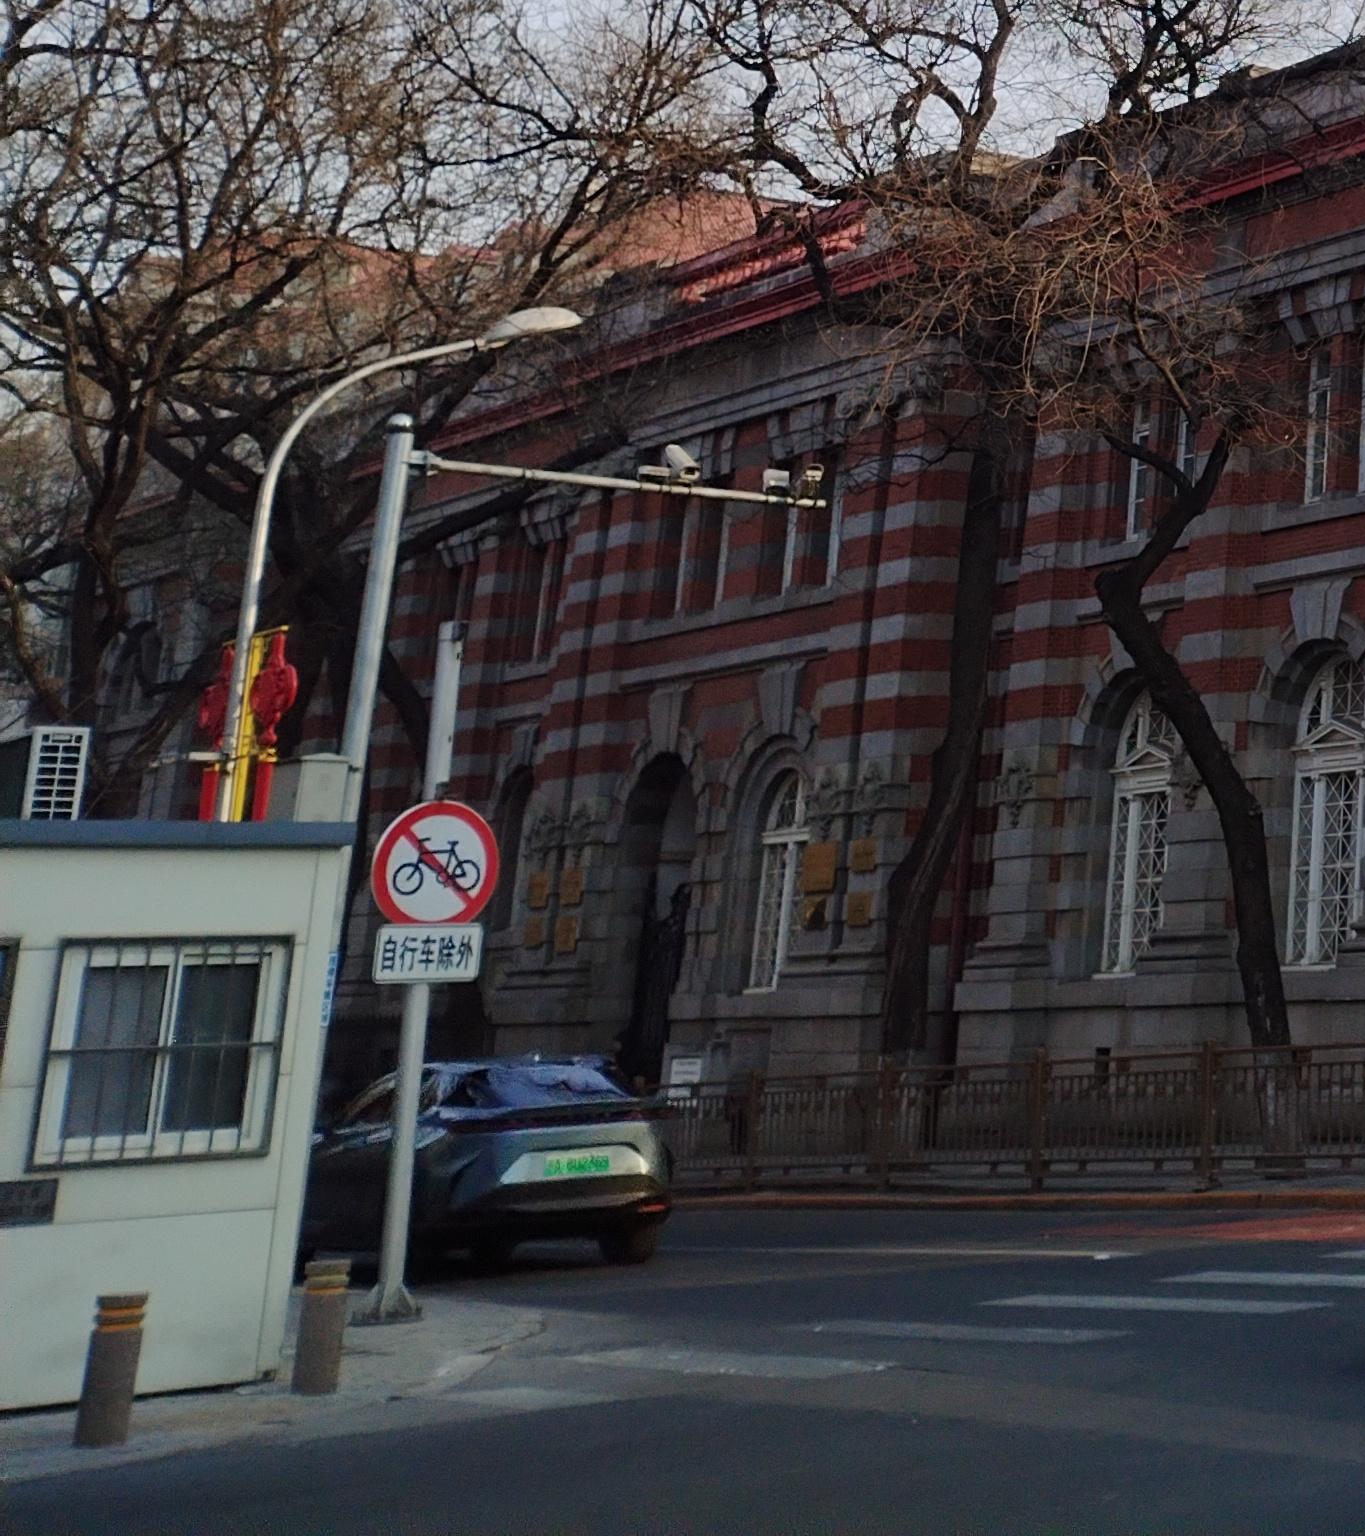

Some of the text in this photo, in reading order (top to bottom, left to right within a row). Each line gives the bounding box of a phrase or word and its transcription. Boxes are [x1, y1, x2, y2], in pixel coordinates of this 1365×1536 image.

[381, 934, 474, 972] 自行车除外
